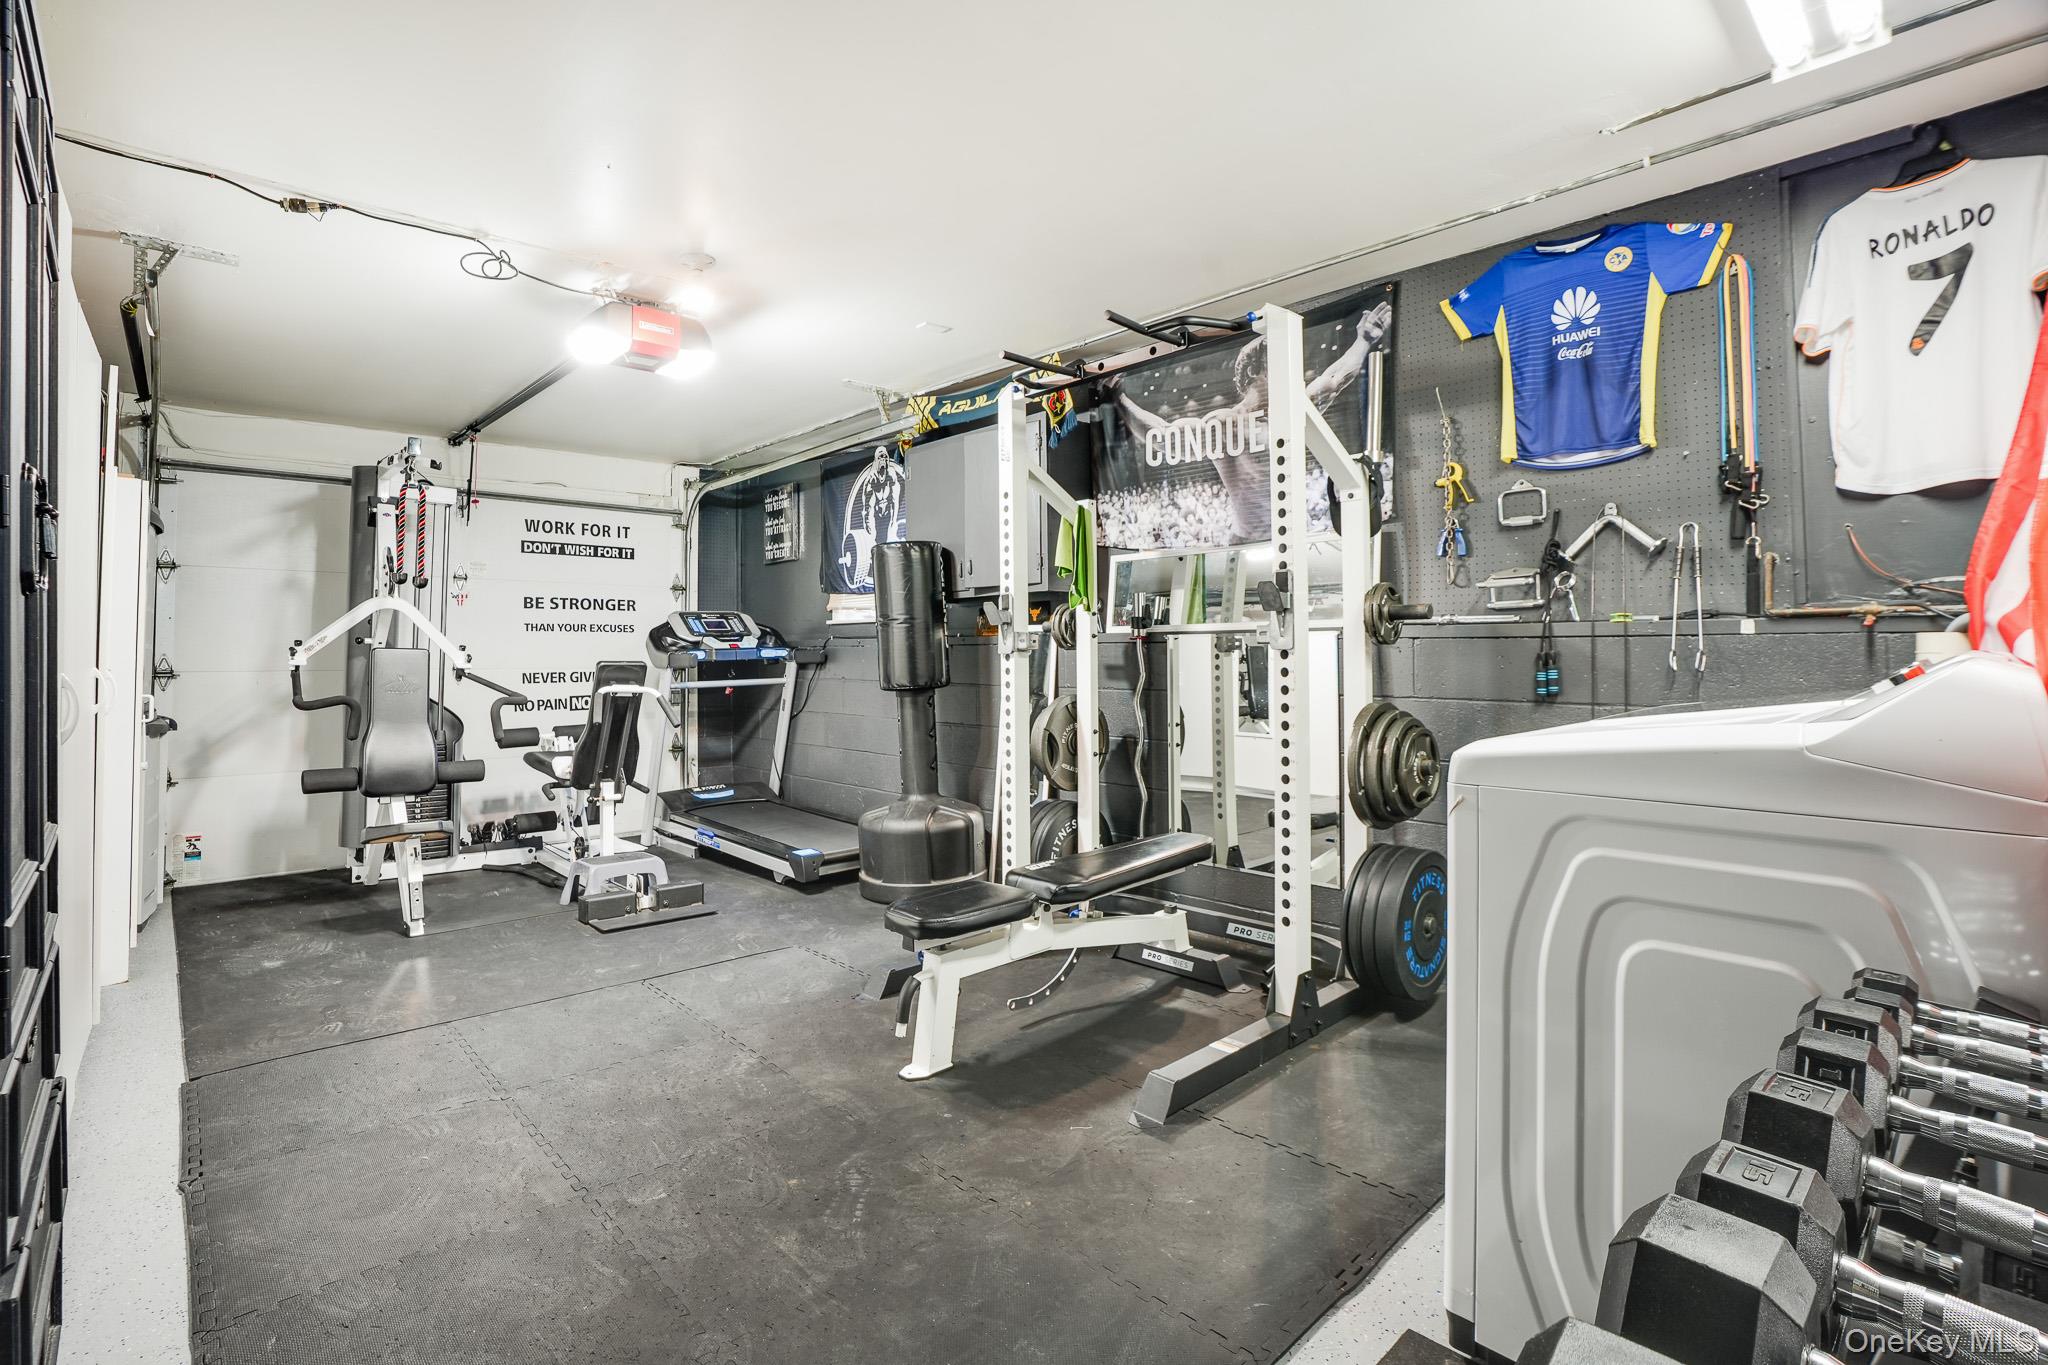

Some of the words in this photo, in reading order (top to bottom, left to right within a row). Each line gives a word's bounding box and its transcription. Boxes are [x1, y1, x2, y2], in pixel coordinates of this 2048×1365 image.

[1869, 203, 1994, 259] RONALDO
[1908, 242, 1974, 356] 7
[1552, 326, 1601, 346] HUAWEI
[1145, 409, 1267, 467] CONQUE
[524, 519, 575, 535] WORK
[581, 523, 611, 538] FOR
[617, 526, 631, 539] IT
[523, 542, 561, 555] DON'T
[564, 544, 594, 556] WISH
[597, 547, 619, 558] FOR
[622, 549, 633, 559] IT
[523, 596, 545, 609] BE
[550, 597, 637, 612] STRONGER
[524, 623, 555, 632] THAN
[557, 623, 587, 633] YOUR
[590, 624, 635, 633] EXCUSES
[522, 672, 566, 684] NEVER
[569, 671, 595, 683] GIV
[537, 698, 568, 711] PAIN
[571, 696, 591, 710] NO
[1412, 871, 1447, 902] FITNESS
[1234, 926, 1253, 937] PRO
[1147, 952, 1162, 961] PRO
[1742, 1159, 1778, 1186] 15
